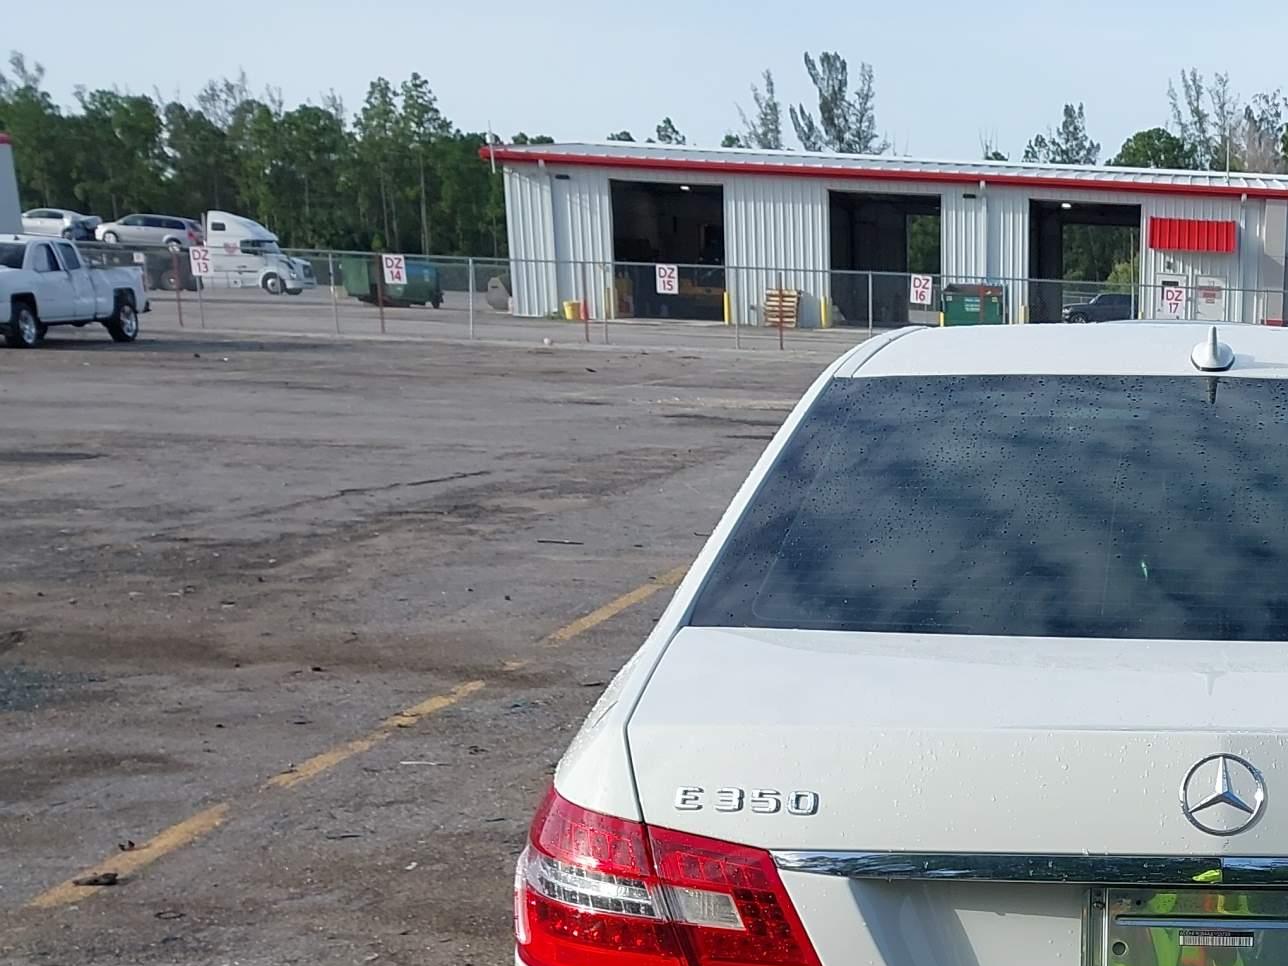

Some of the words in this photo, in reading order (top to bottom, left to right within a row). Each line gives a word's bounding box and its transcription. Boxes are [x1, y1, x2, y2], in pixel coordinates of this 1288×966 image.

[192, 249, 210, 261] DZ
[197, 262, 208, 273] 13
[385, 256, 403, 269] DZ
[390, 270, 402, 281] 14
[658, 266, 675, 279] DZ
[662, 279, 674, 291] 15
[913, 277, 930, 290] DZ
[915, 290, 926, 302] 16
[1166, 289, 1183, 302] DZ
[1169, 302, 1179, 314] 17
